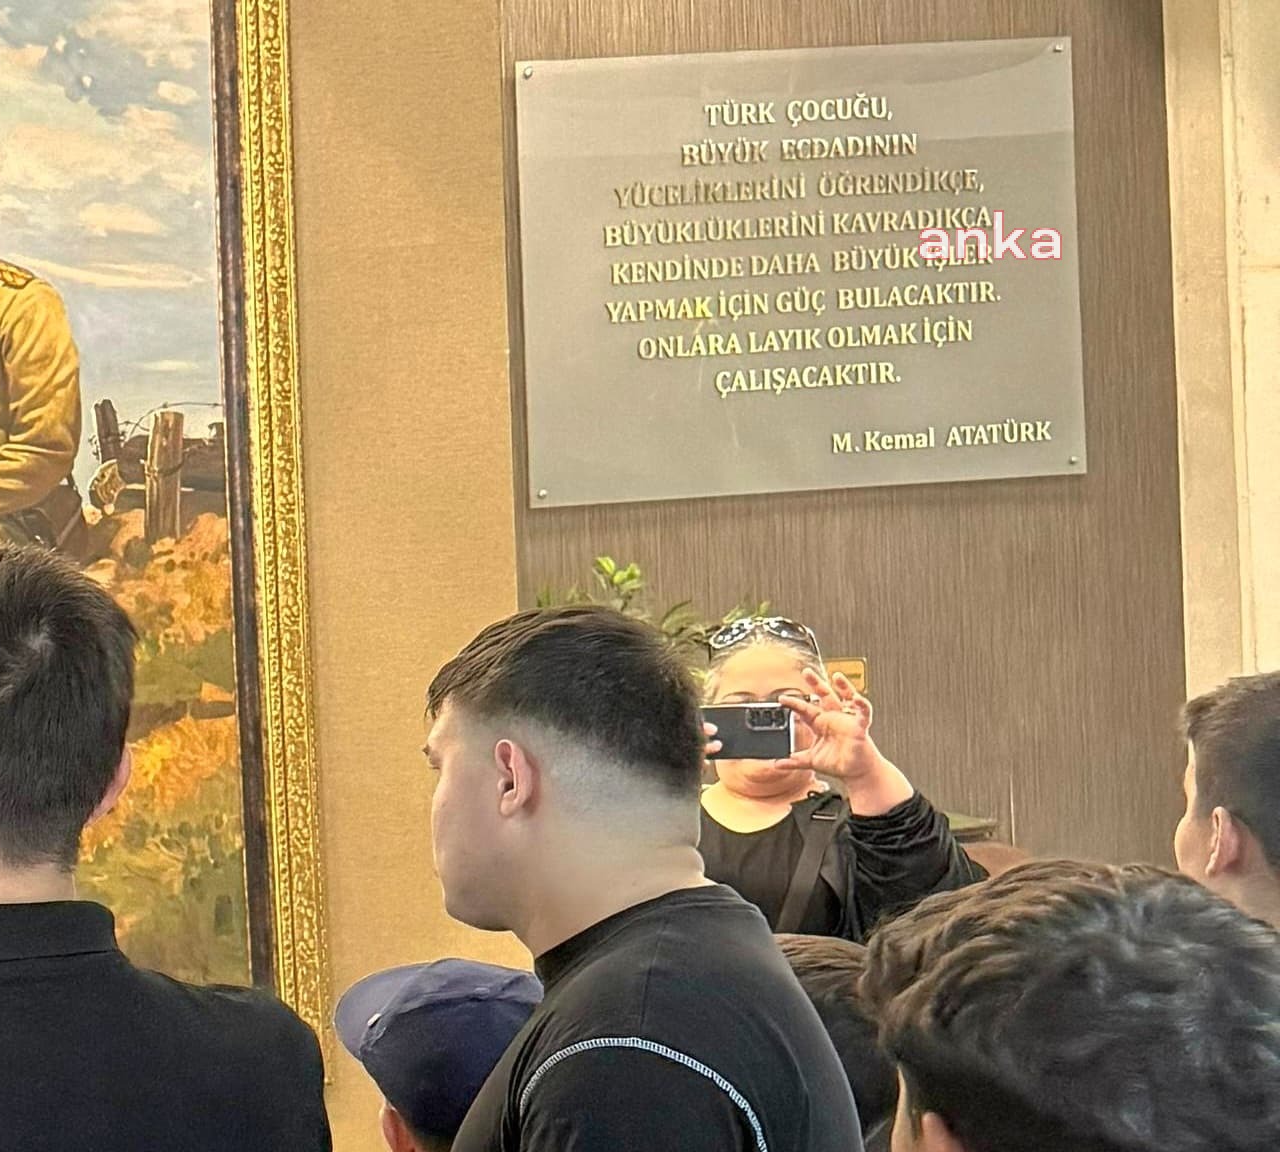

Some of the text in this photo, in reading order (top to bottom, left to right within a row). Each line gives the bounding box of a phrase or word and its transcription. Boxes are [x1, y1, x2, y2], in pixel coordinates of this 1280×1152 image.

[704, 93, 893, 128] TÜRK ÇOCUĞU,
[681, 133, 918, 167] BÜYÜK ECDADININ
[614, 167, 985, 210] YÜCELİKLERİNİ ÖĞRENDİKÇE,
[603, 214, 826, 247] BÜYÜKLÜKLERİNİ
[611, 242, 995, 285] KENDİNDE DAHA BÜYÜK ŞLER
[606, 281, 1001, 324] YAPMAK İÇİN GÜÇ BULACAKTIR.
[638, 319, 973, 360] ONLARA LAYIK OLMAK İÇİN
[715, 361, 902, 399] ÇALIŞACAKTIR.
[832, 419, 1052, 454] M. Kemal ATATÜRK
